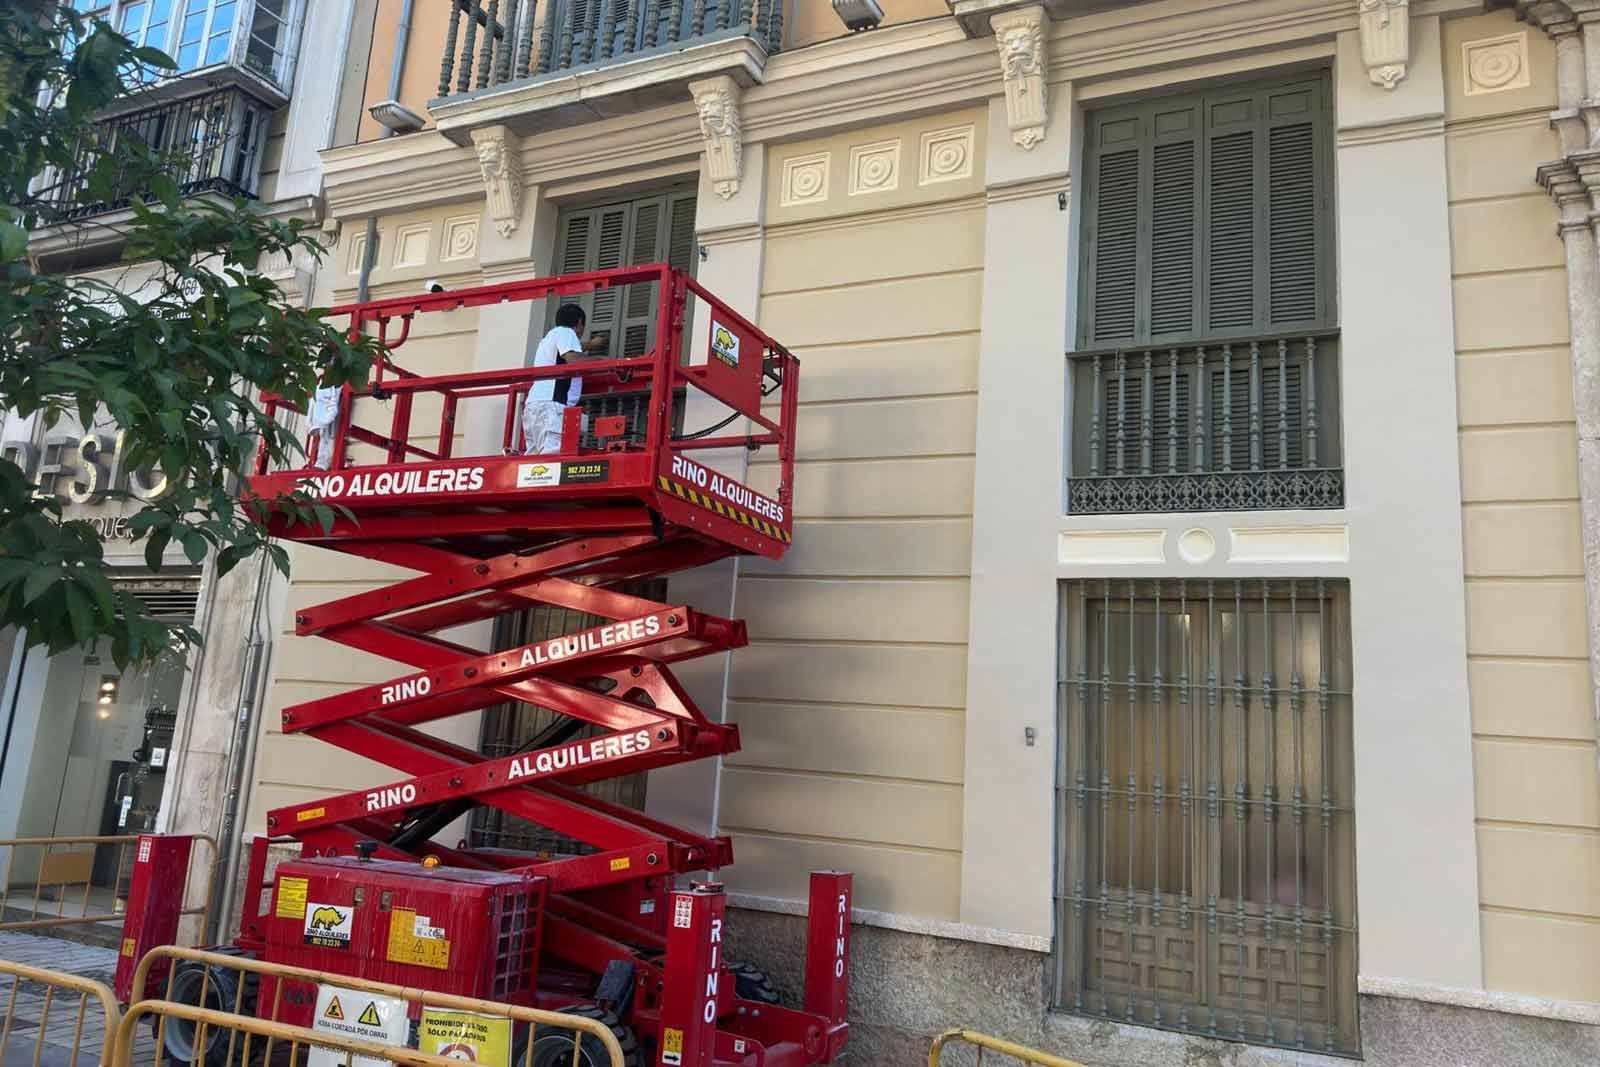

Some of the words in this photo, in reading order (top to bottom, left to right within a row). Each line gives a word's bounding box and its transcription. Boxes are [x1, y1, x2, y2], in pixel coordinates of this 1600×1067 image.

[346, 467, 485, 496] ALQUILERES
[672, 456, 707, 487] RINO
[710, 475, 784, 522] ALQUILERES
[381, 676, 431, 705] RINO
[519, 616, 660, 668] ALQUILERES
[367, 784, 416, 812] RINO
[508, 730, 651, 780] ALQUILERES
[704, 919, 722, 1024] RINO
[836, 895, 846, 977] RINO
